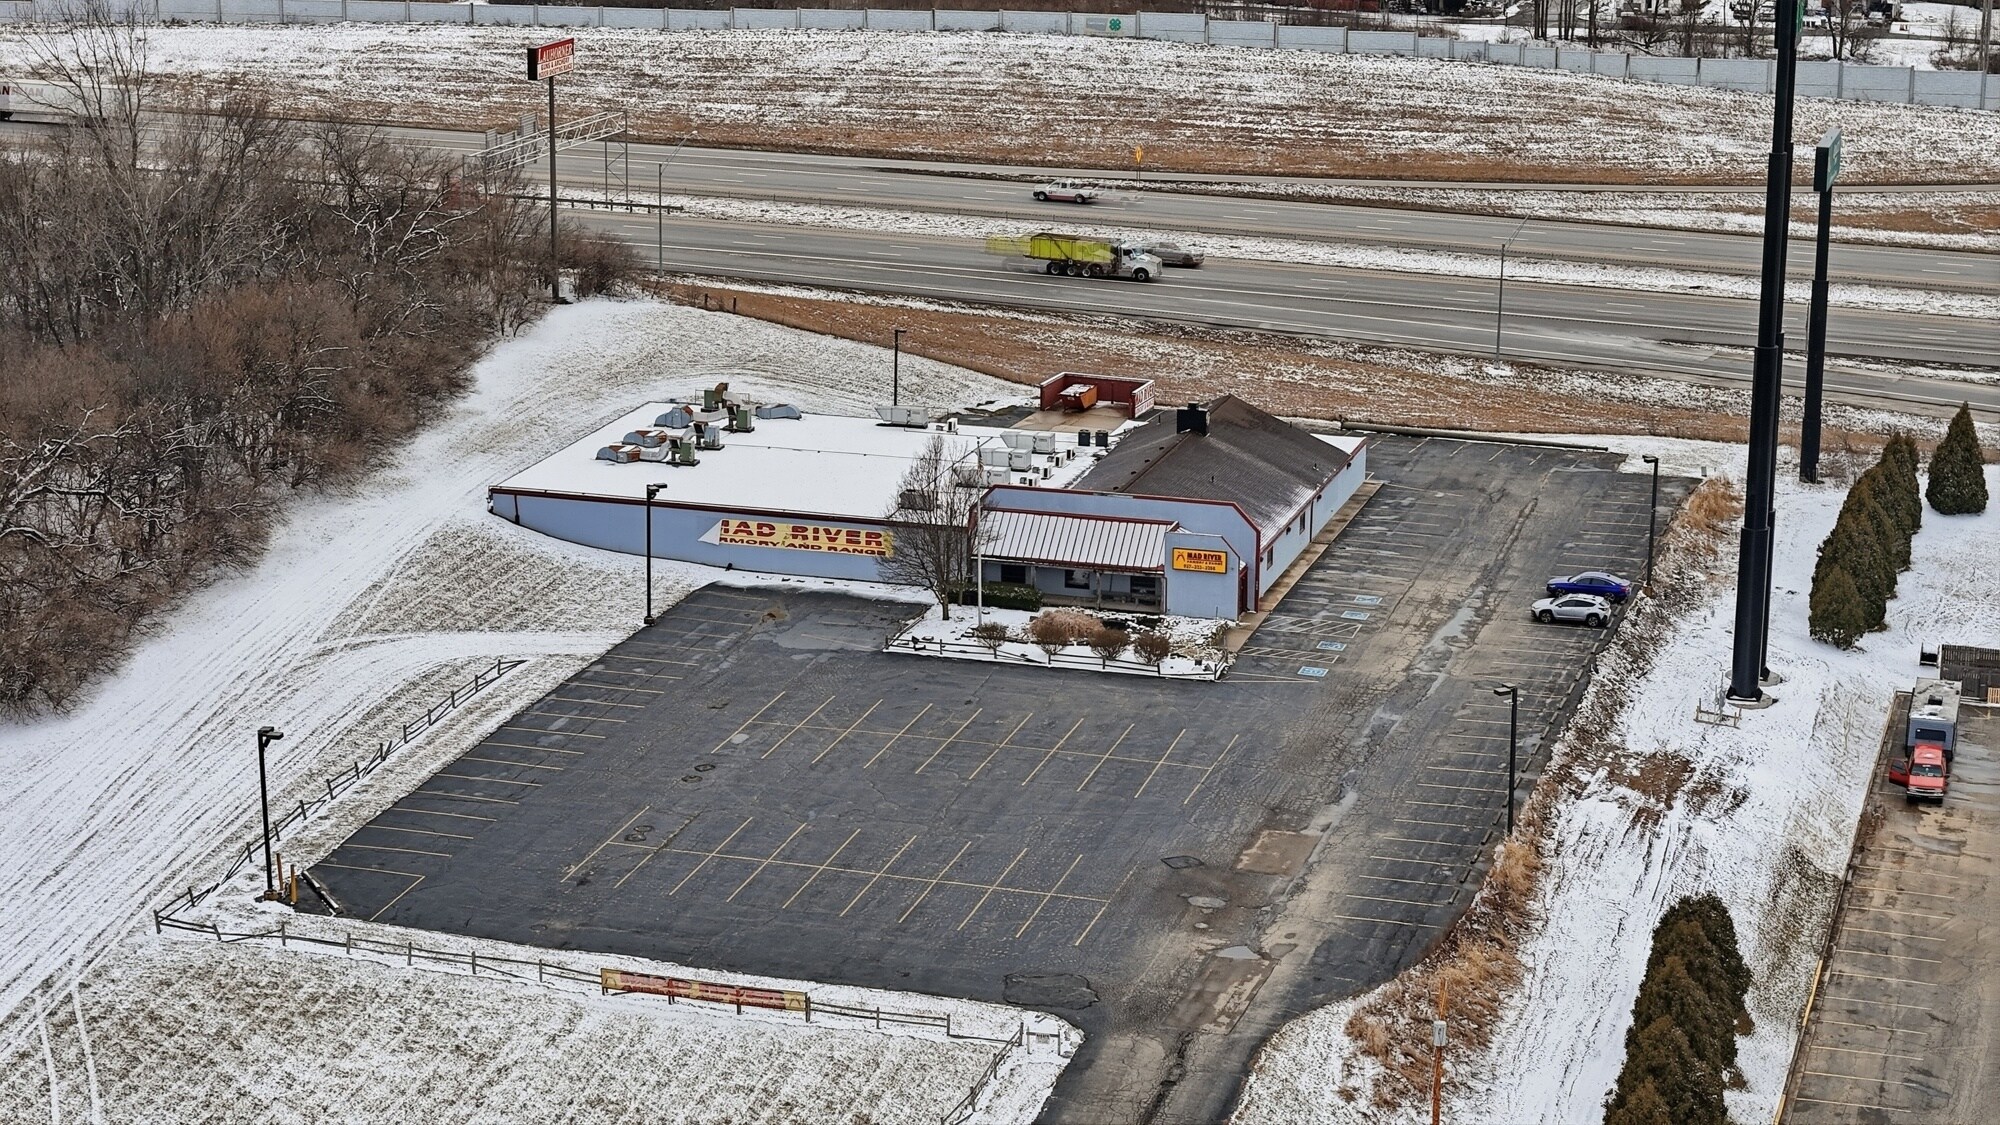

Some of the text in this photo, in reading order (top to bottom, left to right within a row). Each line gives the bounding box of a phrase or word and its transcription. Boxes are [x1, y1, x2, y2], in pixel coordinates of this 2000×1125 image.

[791, 525, 883, 546] RIVER
[720, 536, 886, 556] RMORY AND RANGE
[1187, 552, 1222, 561] MAD RIVER
